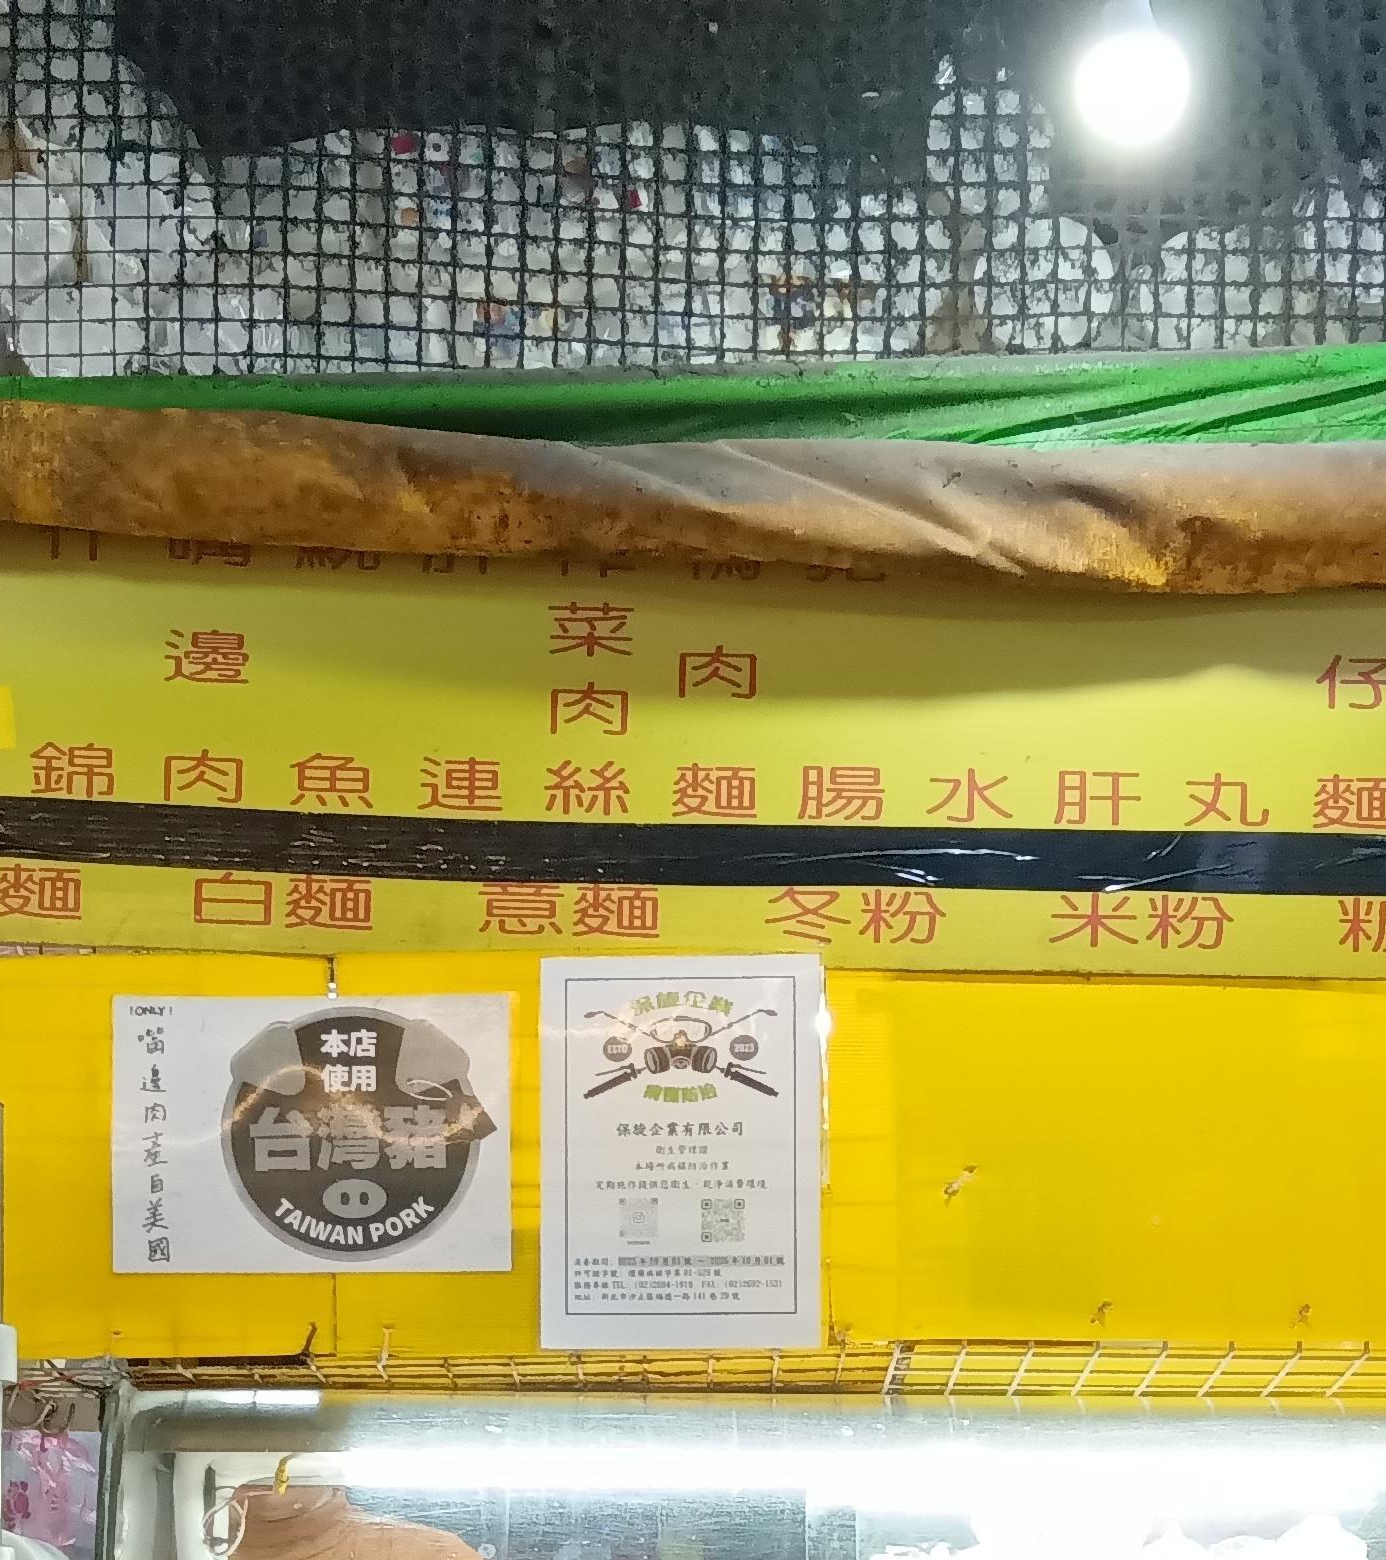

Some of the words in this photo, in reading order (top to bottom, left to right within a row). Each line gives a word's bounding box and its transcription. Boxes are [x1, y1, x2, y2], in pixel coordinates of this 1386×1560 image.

[194, 872, 373, 930] 白麵
[478, 883, 660, 940] 意麵
[765, 887, 946, 945] 冬粉
[1049, 893, 1233, 950] 米粉
[321, 1029, 377, 1058] 本店
[323, 1065, 377, 1092] 使用
[249, 1104, 448, 1171] 台灣豬
[273, 1198, 364, 1246] TAIWAN
[370, 1196, 435, 1244] PORK
